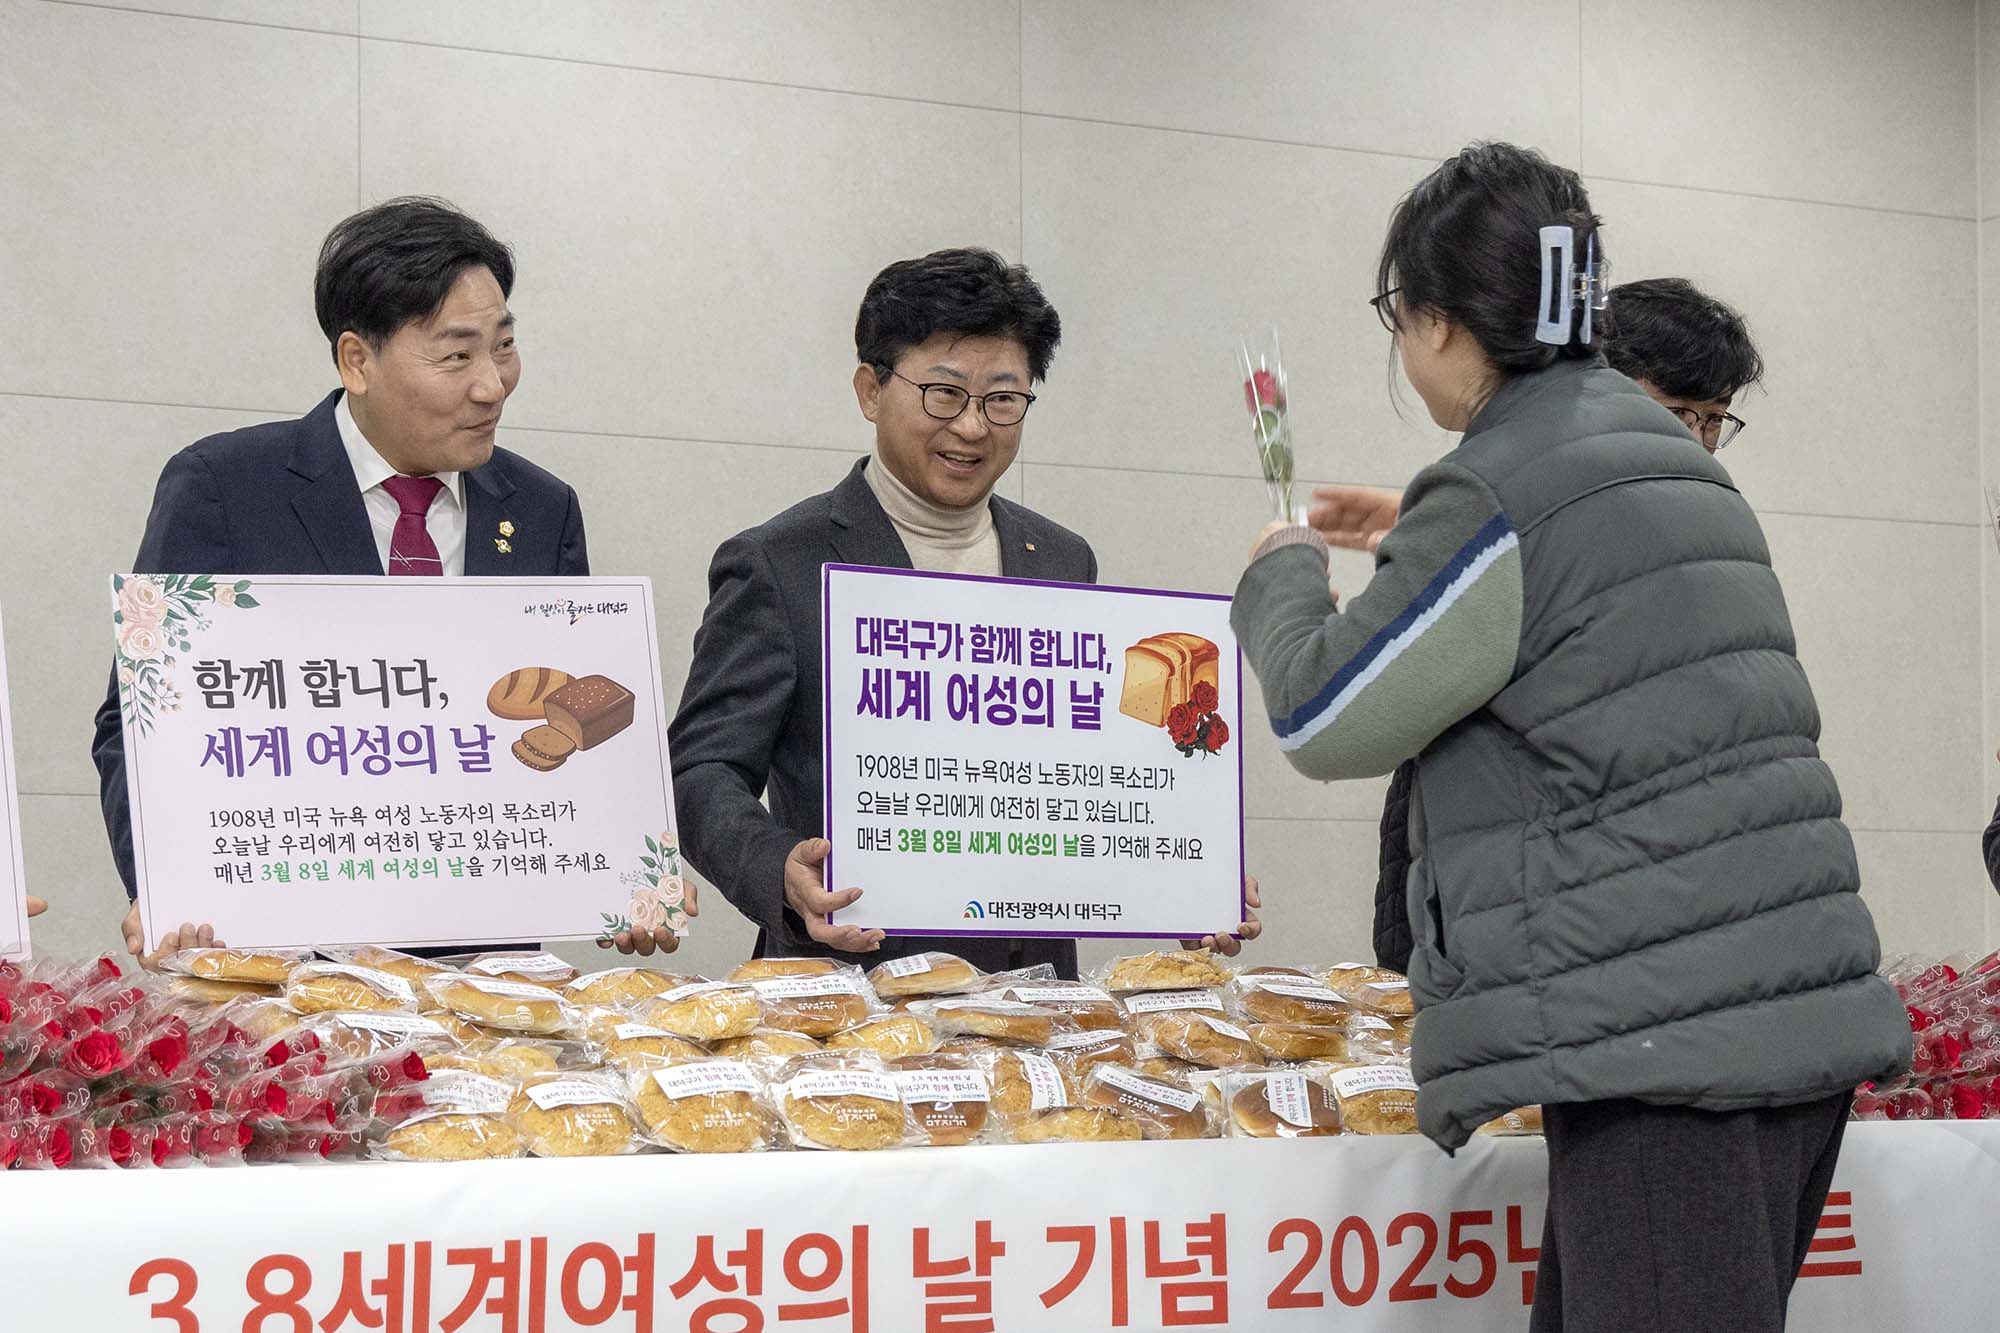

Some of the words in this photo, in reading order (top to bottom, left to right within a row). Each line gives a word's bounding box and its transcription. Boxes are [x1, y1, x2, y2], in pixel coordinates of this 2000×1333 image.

[524, 604, 537, 616] 내
[566, 600, 595, 626] 즐거운
[597, 602, 629, 615] 대덕구
[855, 616, 964, 662] 대덕구가
[969, 623, 1023, 667] 함께
[1028, 629, 1113, 675] 합니다,
[192, 658, 287, 710] 함께
[298, 658, 449, 710] 합니다,
[856, 667, 931, 722] 세계
[946, 672, 1055, 729] 여성의
[1069, 679, 1105, 731] 날
[199, 725, 292, 778] 세계
[306, 724, 438, 775] 여성의
[448, 723, 497, 774] 날
[855, 754, 919, 781] 1908년
[925, 757, 959, 783] 미국
[1037, 762, 1104, 789] 노동자의
[1109, 765, 1176, 792] 목소리가
[209, 806, 276, 829] 1908년
[283, 805, 323, 829] 미국
[328, 805, 368, 828] 뉴욕
[374, 804, 411, 827] 여성
[419, 802, 494, 826] 노동자의
[501, 800, 577, 824] 목소리가
[856, 790, 910, 816] 오늘날
[914, 792, 984, 819] 우리에게
[990, 795, 1040, 821] 여전히
[1045, 798, 1079, 822] 닿고
[1084, 800, 1155, 825] 있습니다.
[211, 833, 272, 857] 오늘날
[277, 831, 356, 857] 우리에게
[363, 830, 420, 855] 여전히
[426, 829, 467, 853] 닿고
[472, 827, 553, 852] 있습니다.
[857, 826, 892, 852] 매년
[897, 828, 927, 853] 3월
[932, 829, 962, 854] 8일
[967, 830, 1002, 856] 세계
[1007, 831, 1057, 857] 여성의
[1062, 833, 1096, 858] 날을
[1101, 834, 1150, 860] 기억해
[1155, 836, 1204, 861] 주세요
[213, 861, 254, 885] 매년
[261, 860, 292, 883] 3월
[298, 859, 330, 882] 8일
[337, 858, 375, 881] 세계
[383, 856, 439, 881] 여성의
[446, 855, 485, 878] 날을
[491, 853, 547, 877] 기억해
[553, 851, 611, 875] 주세요
[988, 901, 1070, 920] 대전광역시
[1074, 903, 1123, 921] 대덕구
[913, 1221, 1005, 1333] 날
[1040, 1213, 1229, 1326] 기념
